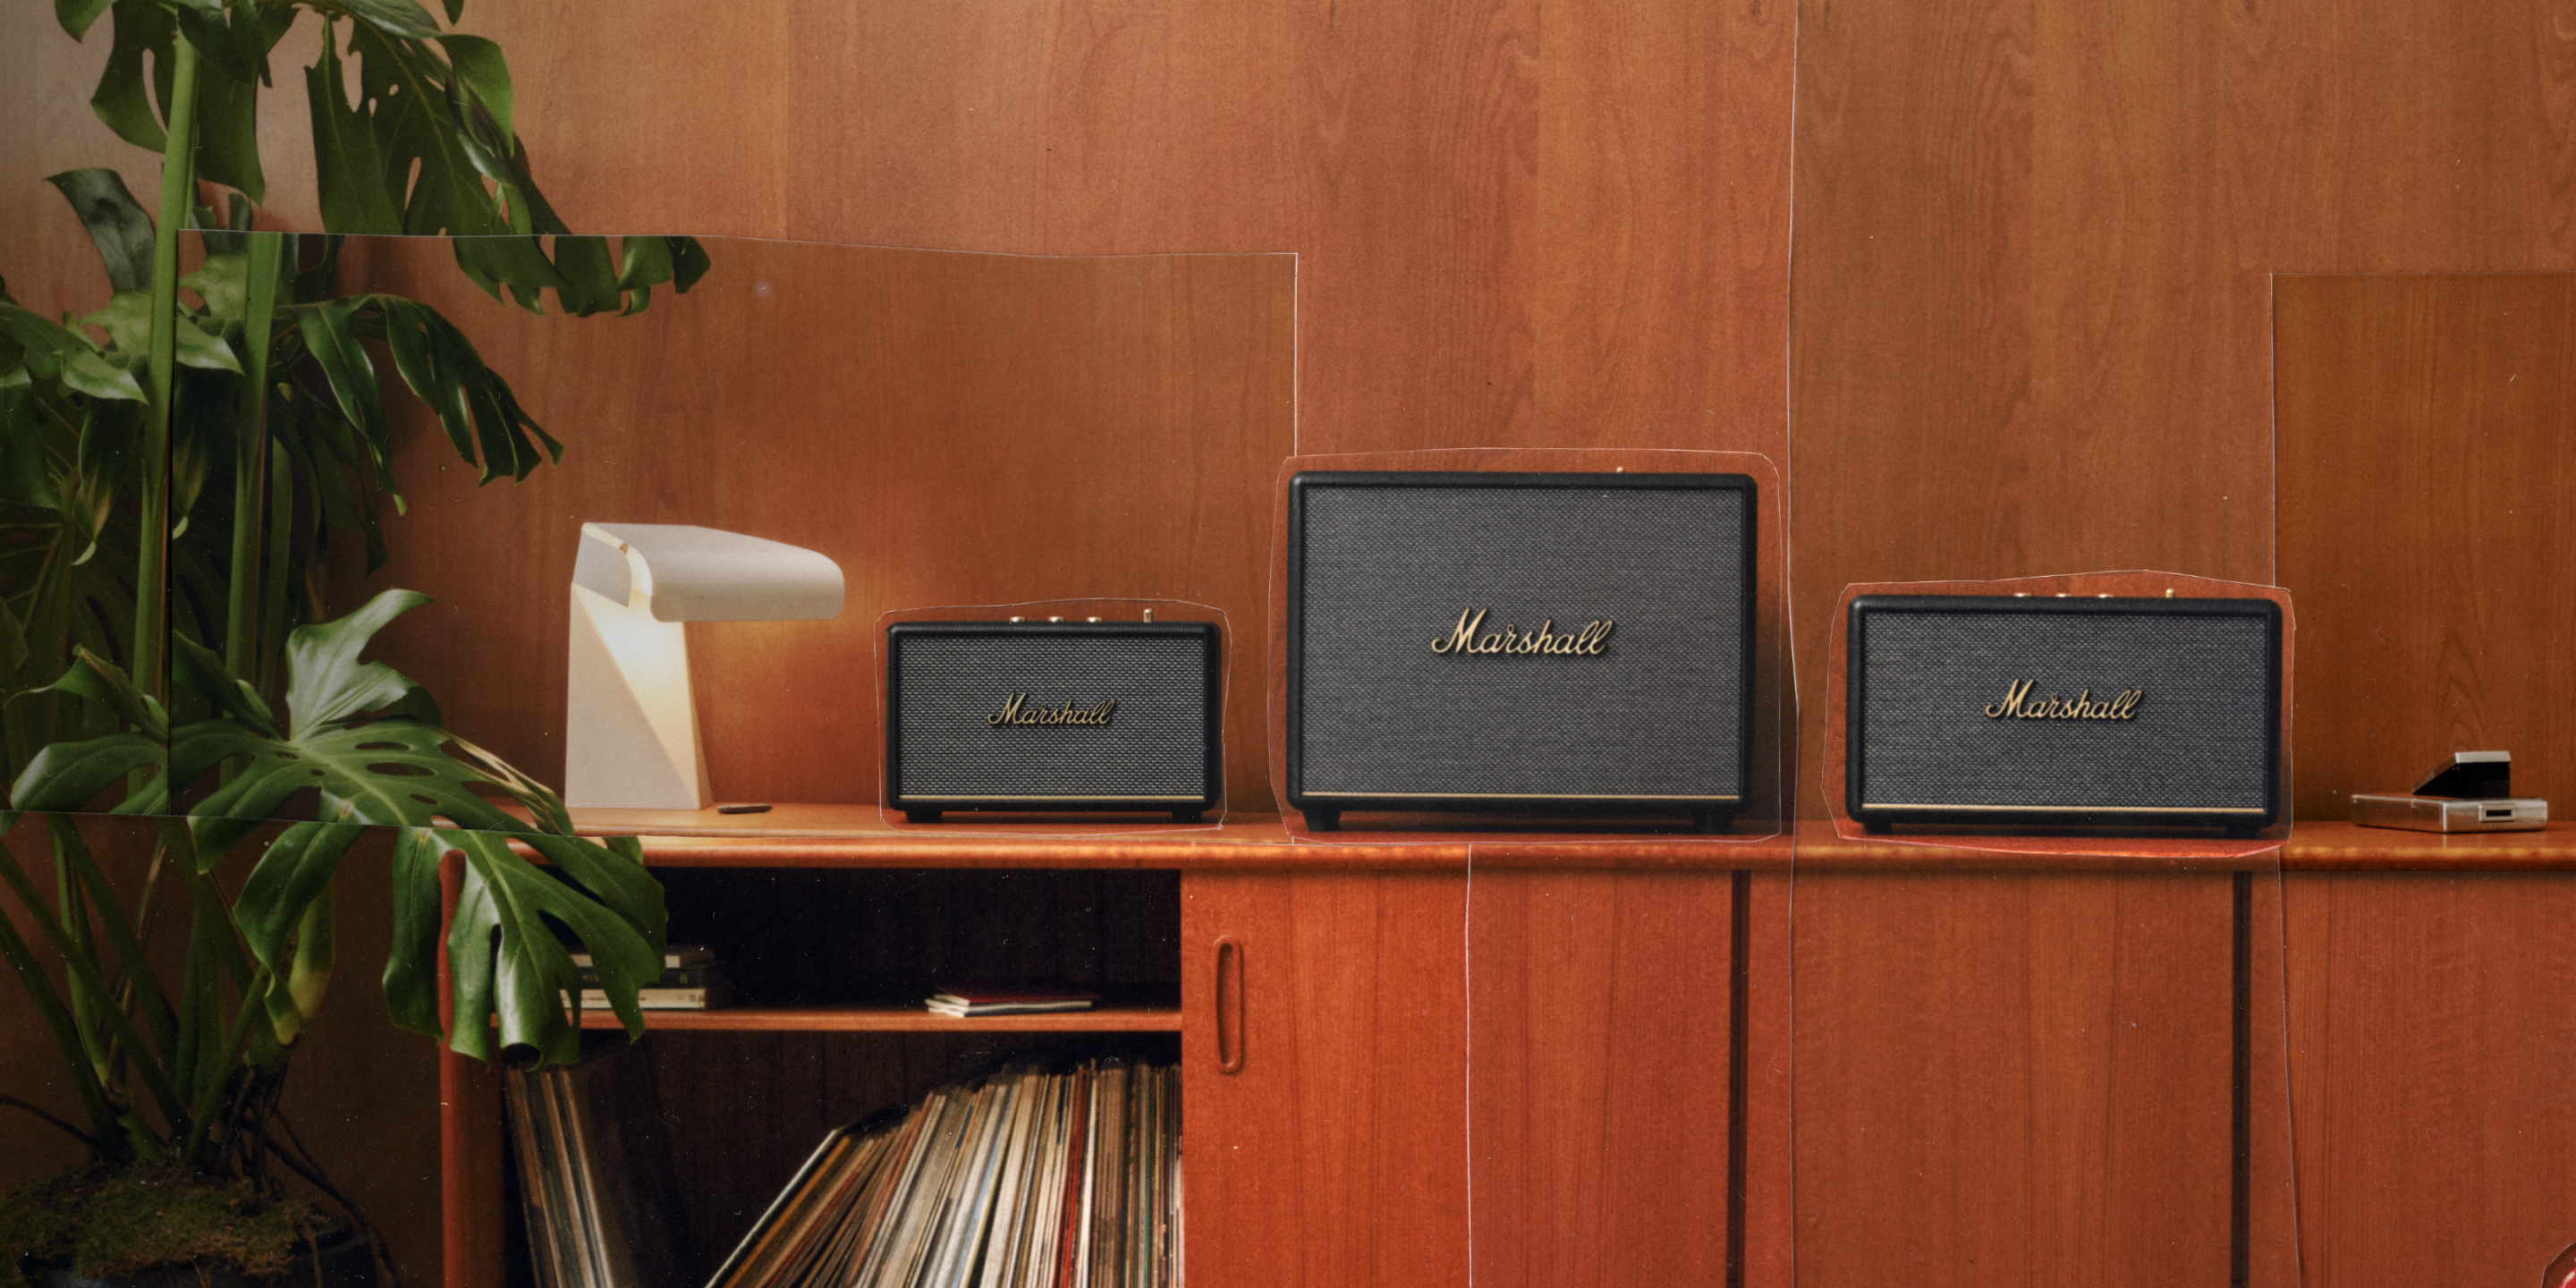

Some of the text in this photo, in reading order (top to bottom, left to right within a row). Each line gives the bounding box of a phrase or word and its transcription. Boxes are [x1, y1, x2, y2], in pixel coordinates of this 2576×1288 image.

[1432, 607, 1613, 655] Marshall
[987, 692, 1114, 724] Marshall
[1985, 678, 2142, 719] Marshall
